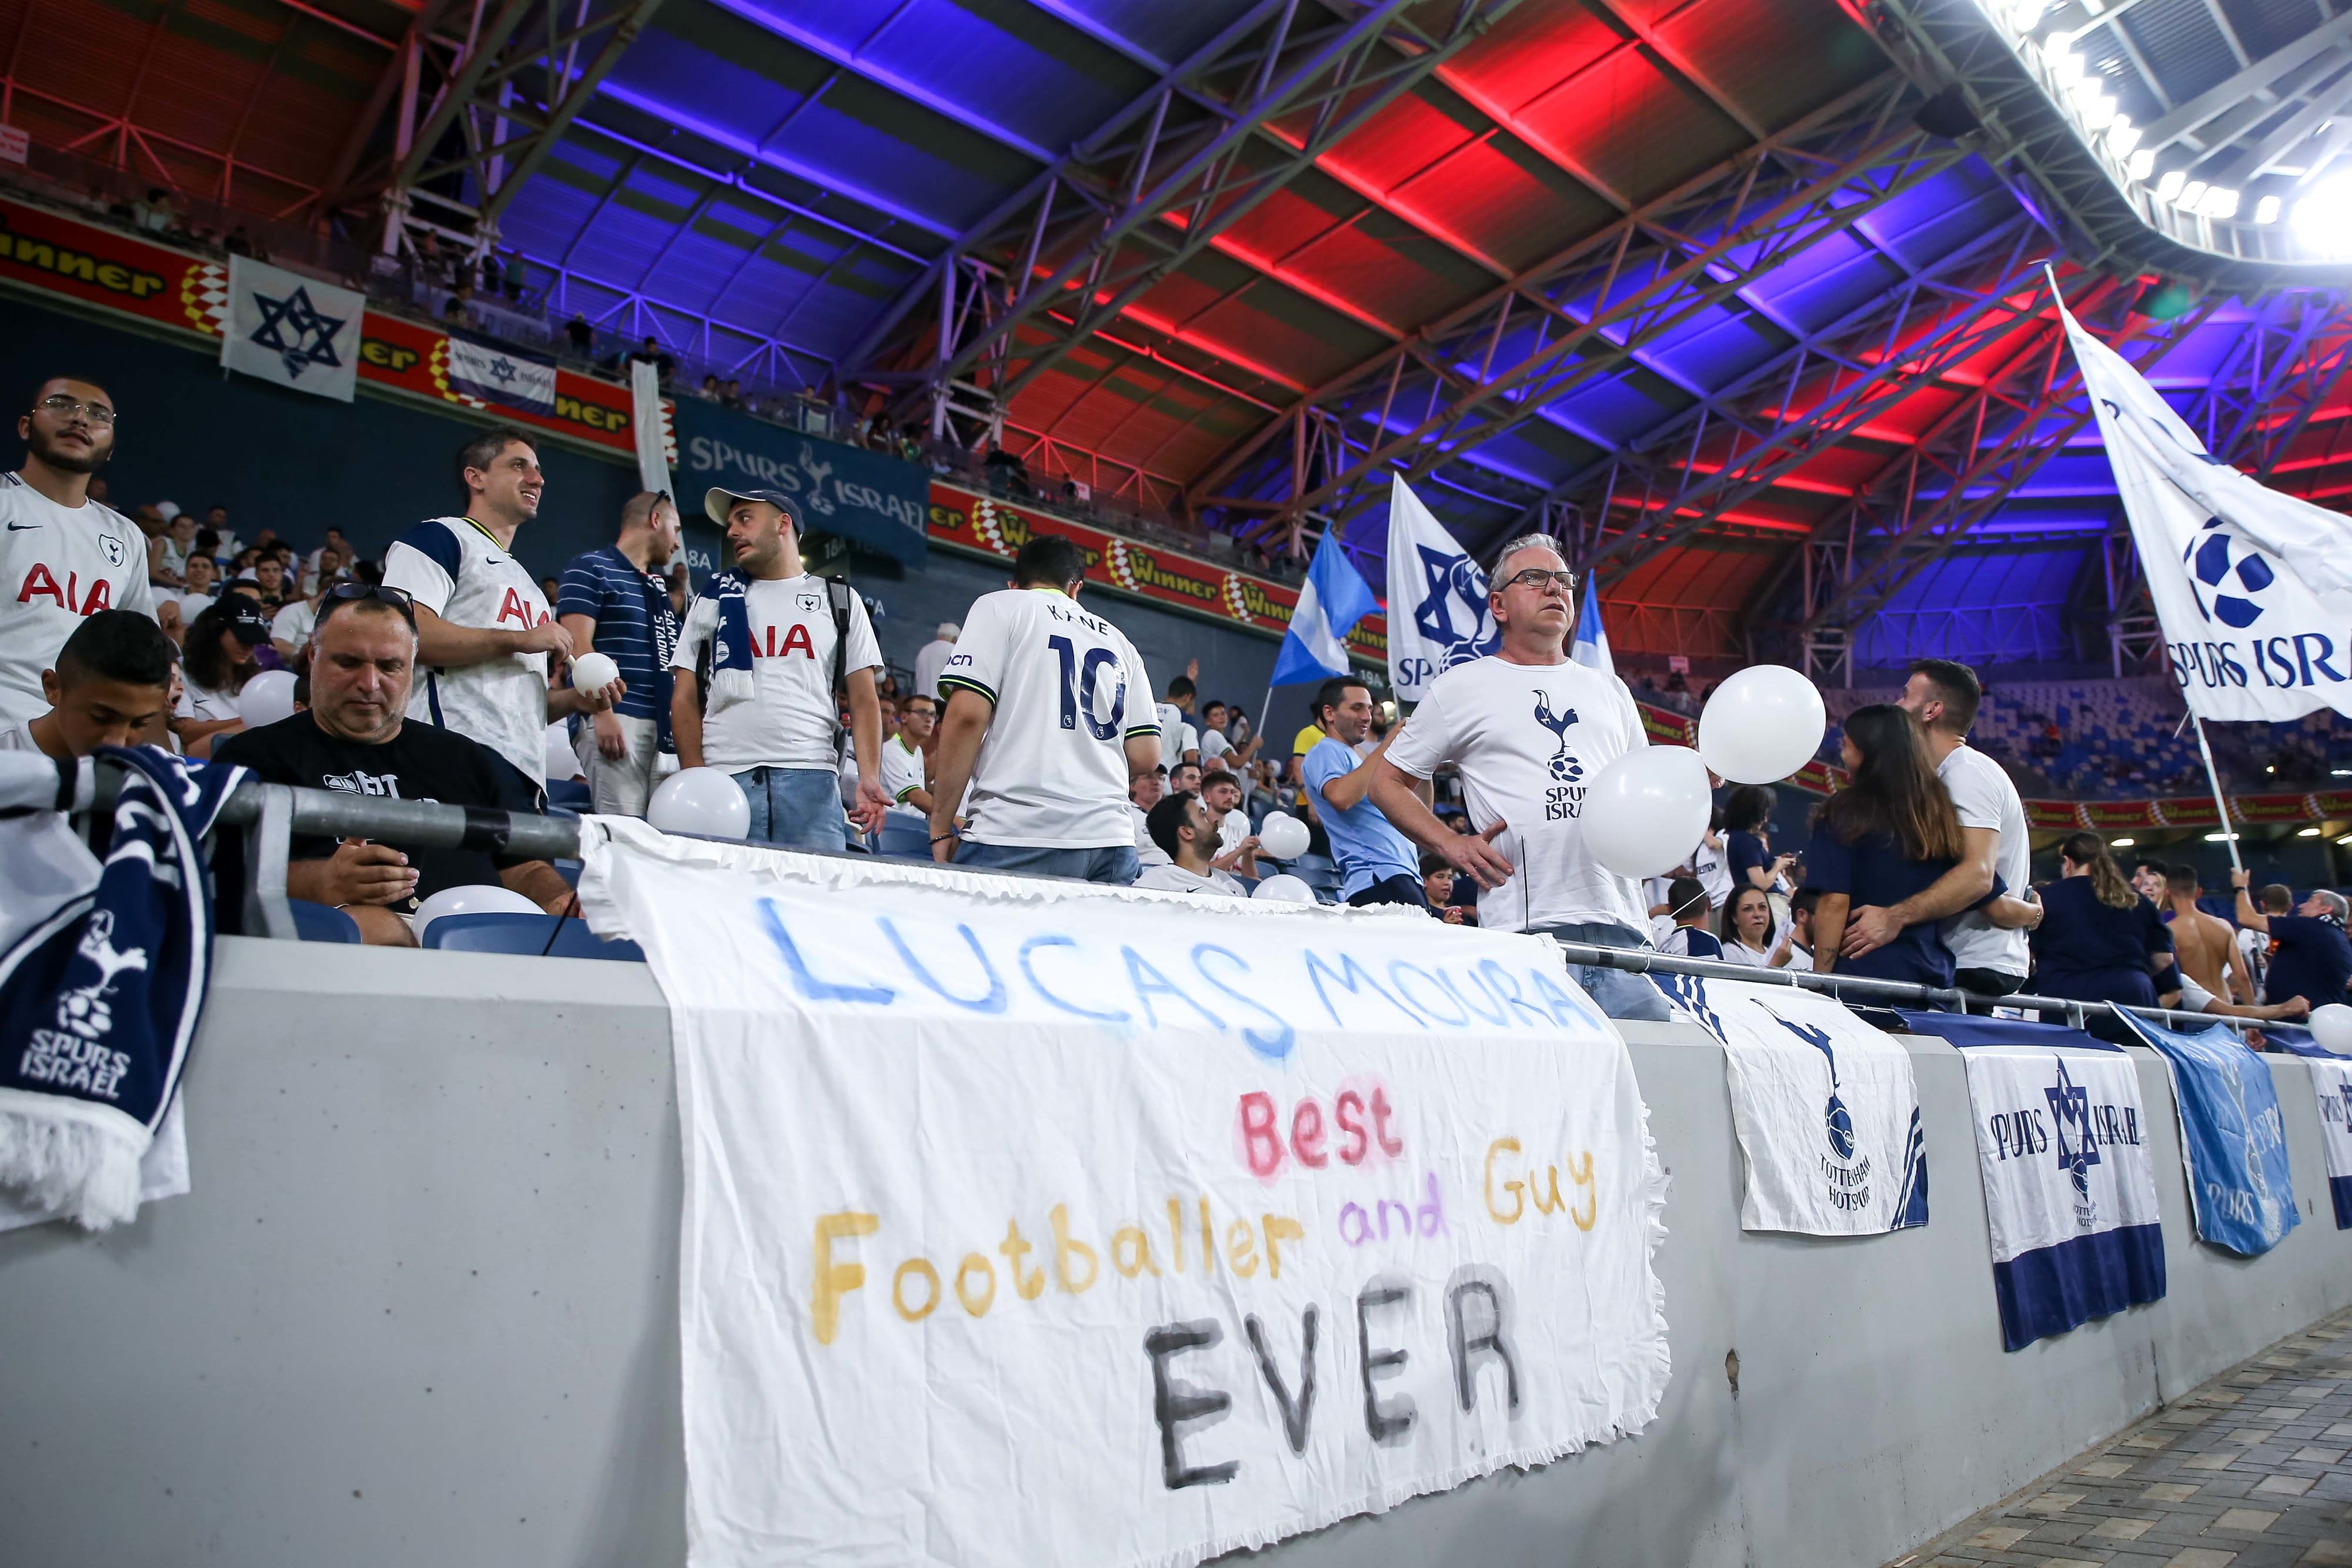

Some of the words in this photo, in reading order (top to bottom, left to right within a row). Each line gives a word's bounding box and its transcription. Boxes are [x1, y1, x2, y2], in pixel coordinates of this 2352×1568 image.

[690, 436, 802, 493] SPURS
[834, 479, 928, 538] ISRAEL
[17, 563, 111, 616] AIA
[1127, 550, 1218, 601] Winner
[653, 615, 670, 672] STADIUM
[664, 609, 679, 651] SAMMY
[2167, 641, 2247, 688] SPURS
[2251, 629, 2352, 689] ISR
[1048, 634, 1126, 741] 10
[756, 897, 1294, 1060] LUCAS
[1304, 947, 1602, 1031] MOURA
[19, 1048, 120, 1099] ISRAEL
[31, 1029, 131, 1078] SPURS
[1237, 1085, 1404, 1179] Best
[1990, 1108, 2048, 1162] SPURS
[1820, 1153, 1871, 1188] TOTTENHAM
[1829, 1185, 1870, 1211] HOTSPUR
[811, 1193, 1305, 1346] Footballer
[1338, 1171, 1449, 1246] and
[1484, 1136, 1596, 1232] Guy
[1144, 1270, 1524, 1489] EVER
